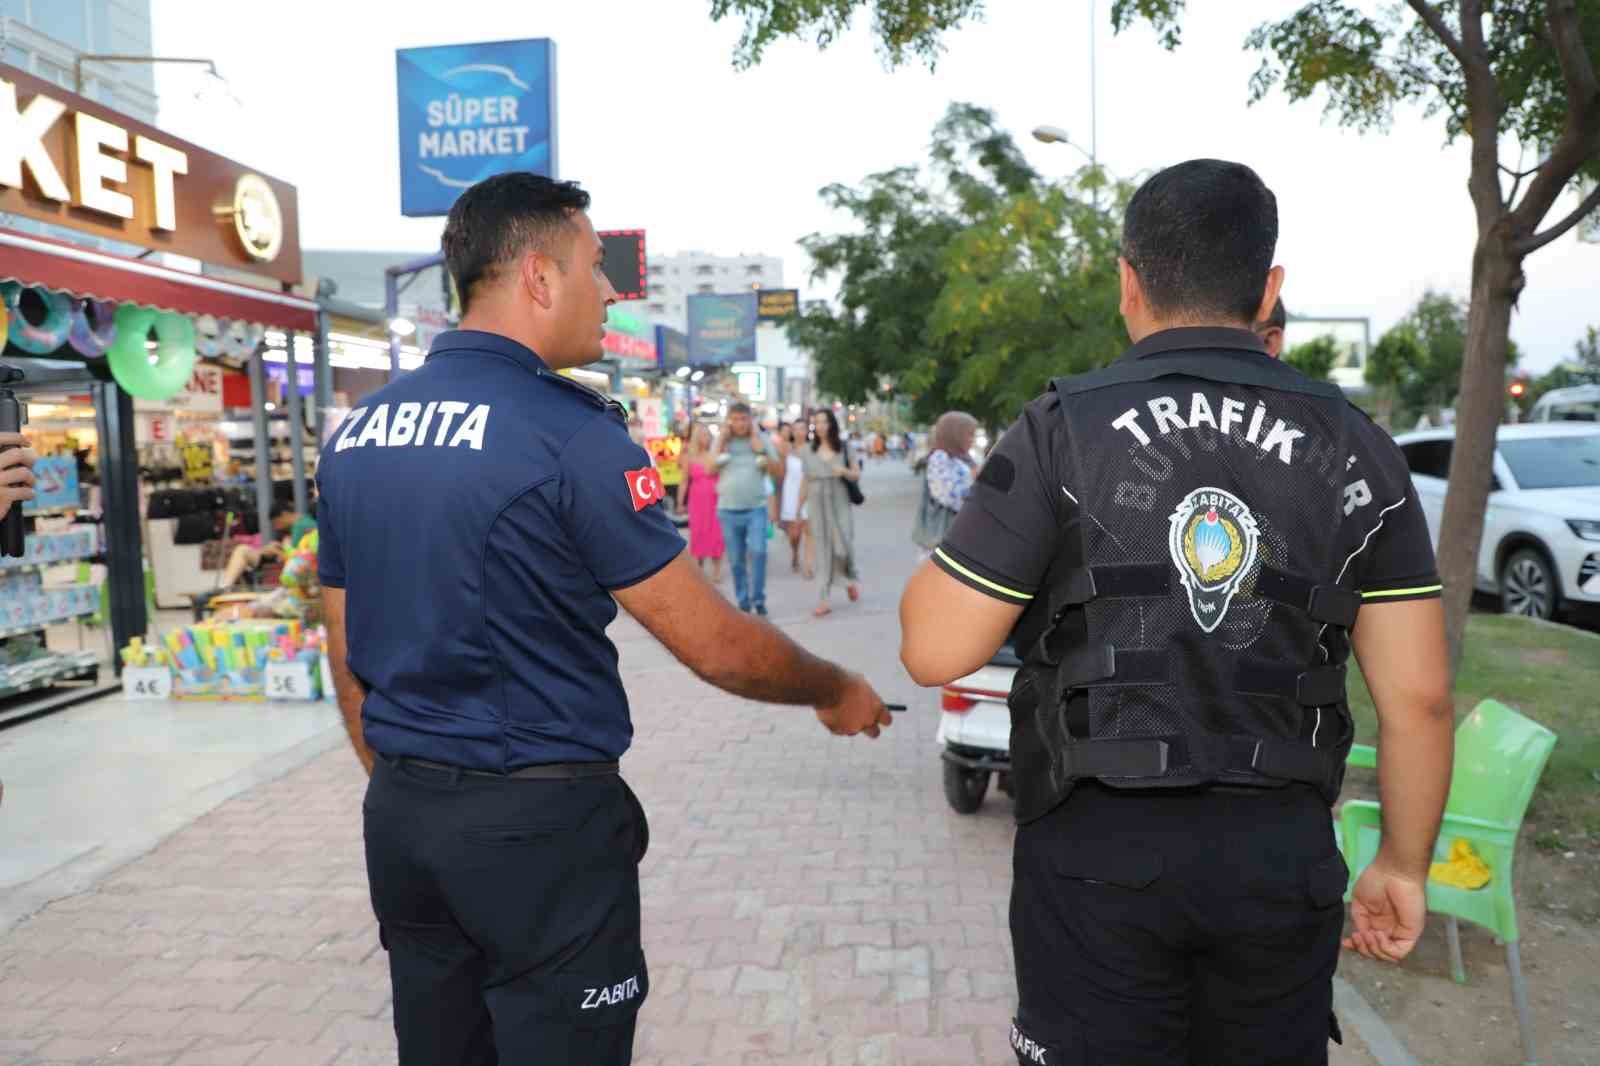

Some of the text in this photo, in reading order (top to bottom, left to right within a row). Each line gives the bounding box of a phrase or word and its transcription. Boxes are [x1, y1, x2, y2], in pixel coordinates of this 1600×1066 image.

[427, 92, 518, 128] SÜPER
[418, 126, 528, 158] MARKET
[334, 401, 491, 453] ZABITA
[1112, 392, 1305, 465] TRAFİK
[581, 975, 639, 1009] ZABITA
